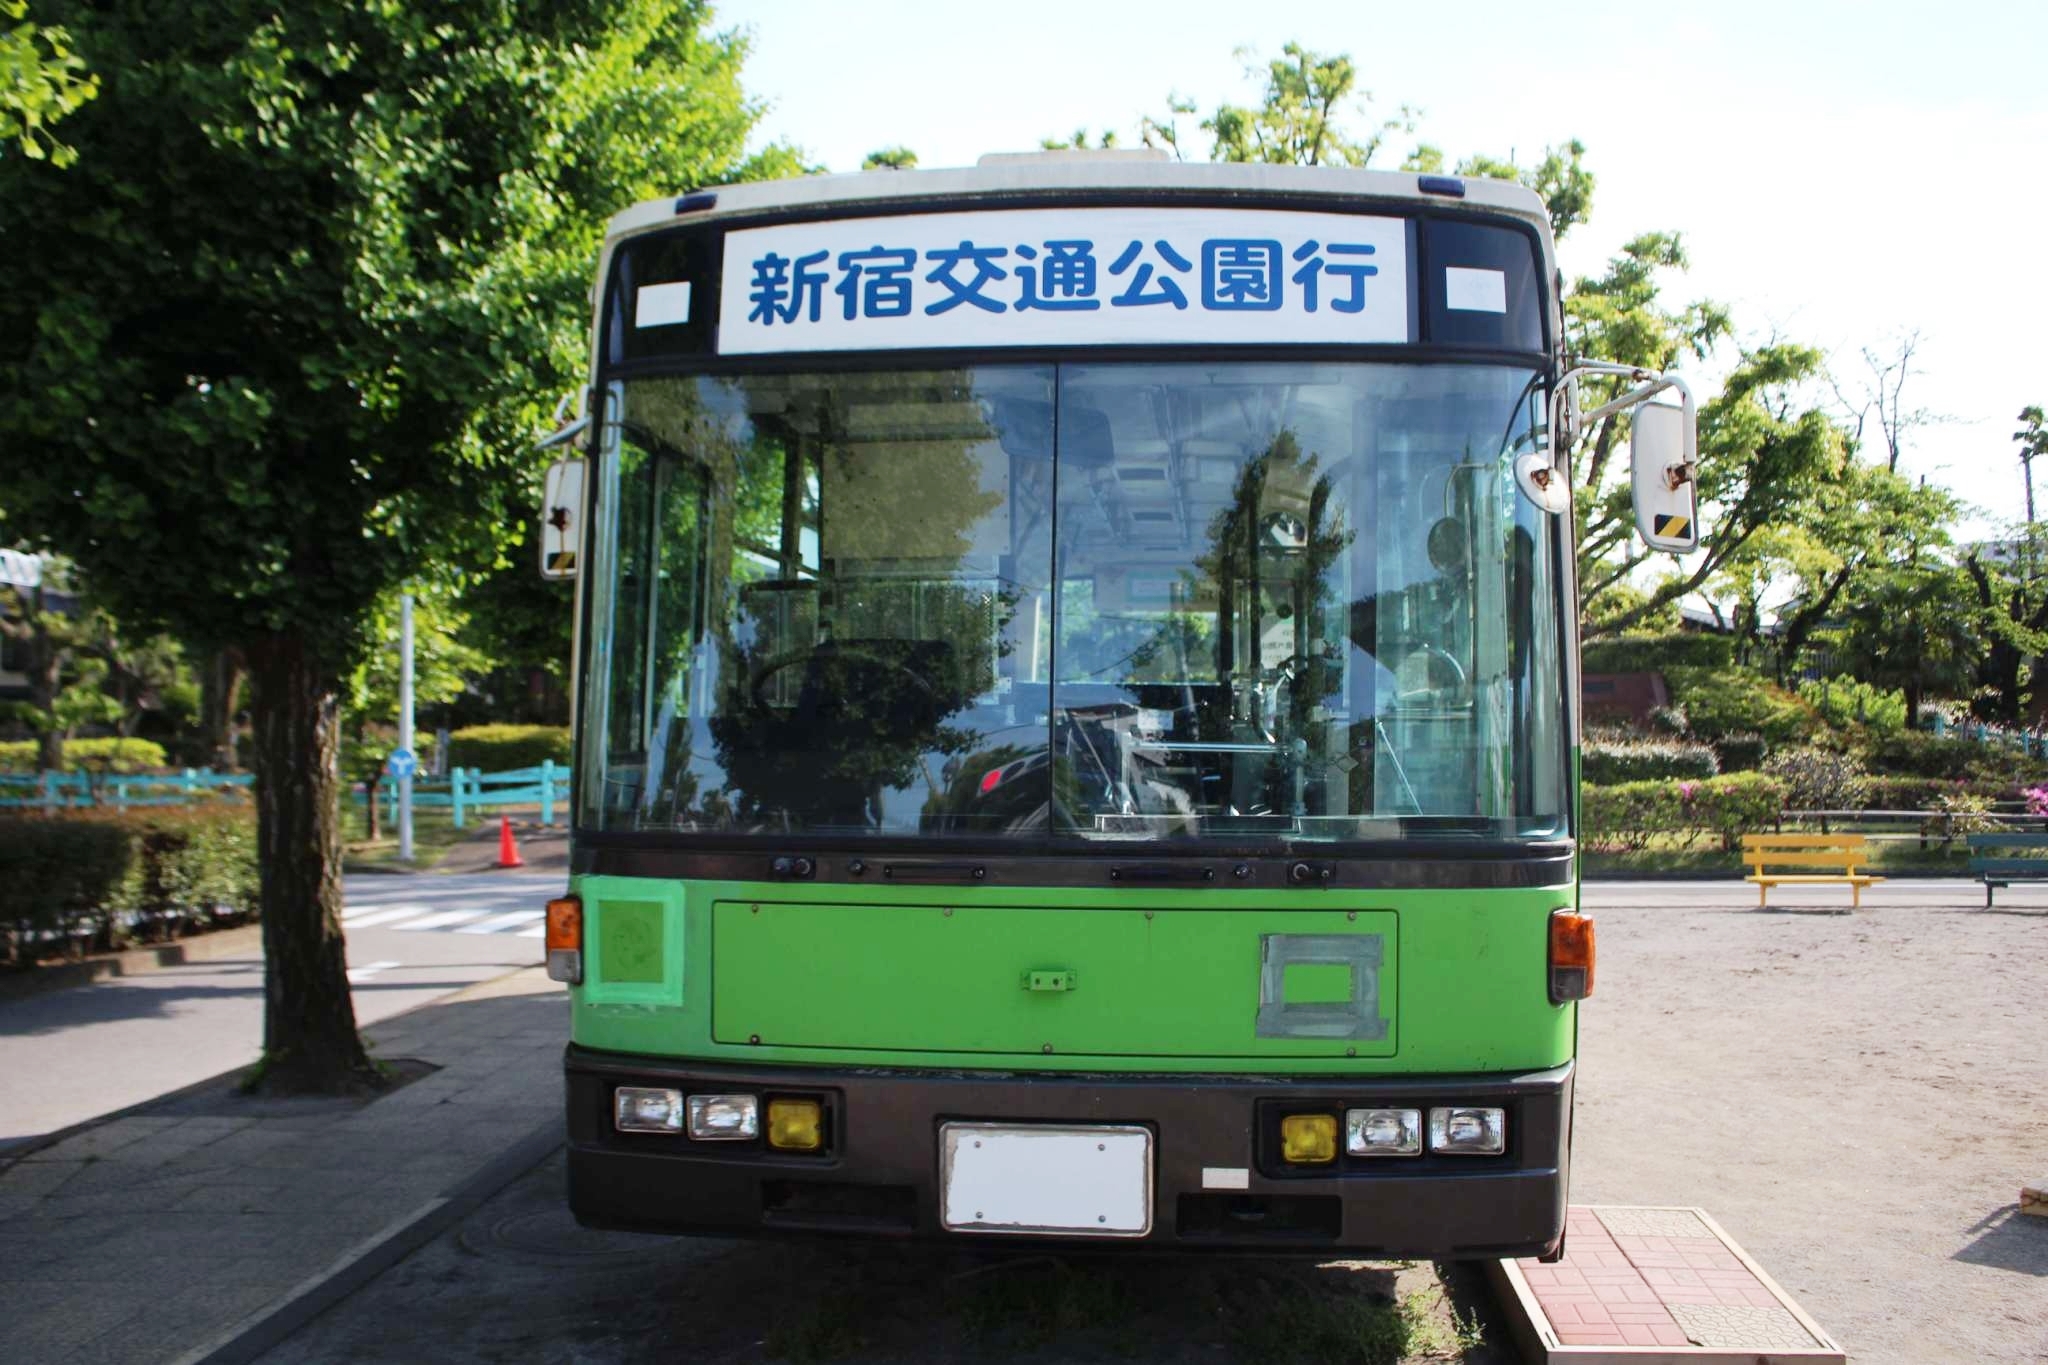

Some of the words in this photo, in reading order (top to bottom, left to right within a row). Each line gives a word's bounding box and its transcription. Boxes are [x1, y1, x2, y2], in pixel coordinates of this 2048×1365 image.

[748, 239, 1379, 326] 新宿交通公園行
